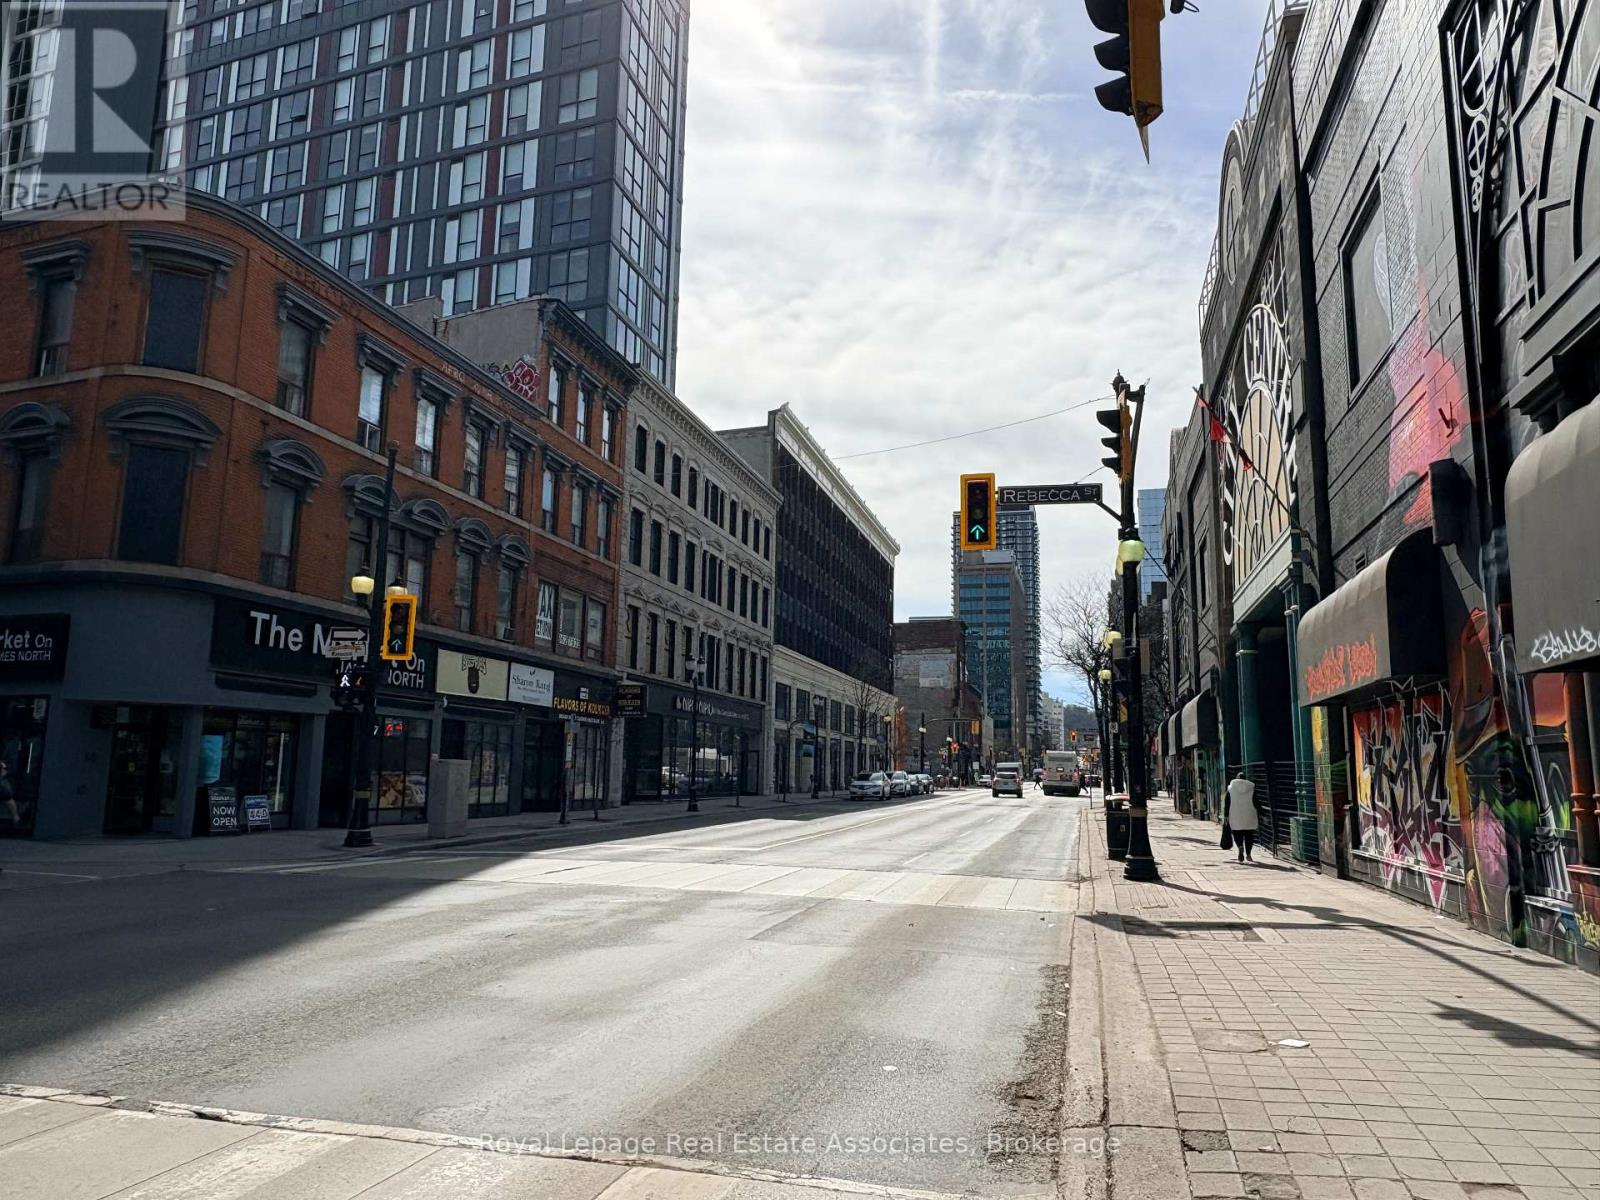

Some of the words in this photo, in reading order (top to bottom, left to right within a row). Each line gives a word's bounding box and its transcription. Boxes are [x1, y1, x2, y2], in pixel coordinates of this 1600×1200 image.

[1003, 489, 1080, 502] REBECCA
[249, 610, 303, 652] The
[35, 633, 54, 650] On
[18, 650, 52, 662] NORTH
[553, 696, 579, 712] FLAVORS
[213, 806, 237, 816] NOW
[213, 817, 239, 827] OPEN
